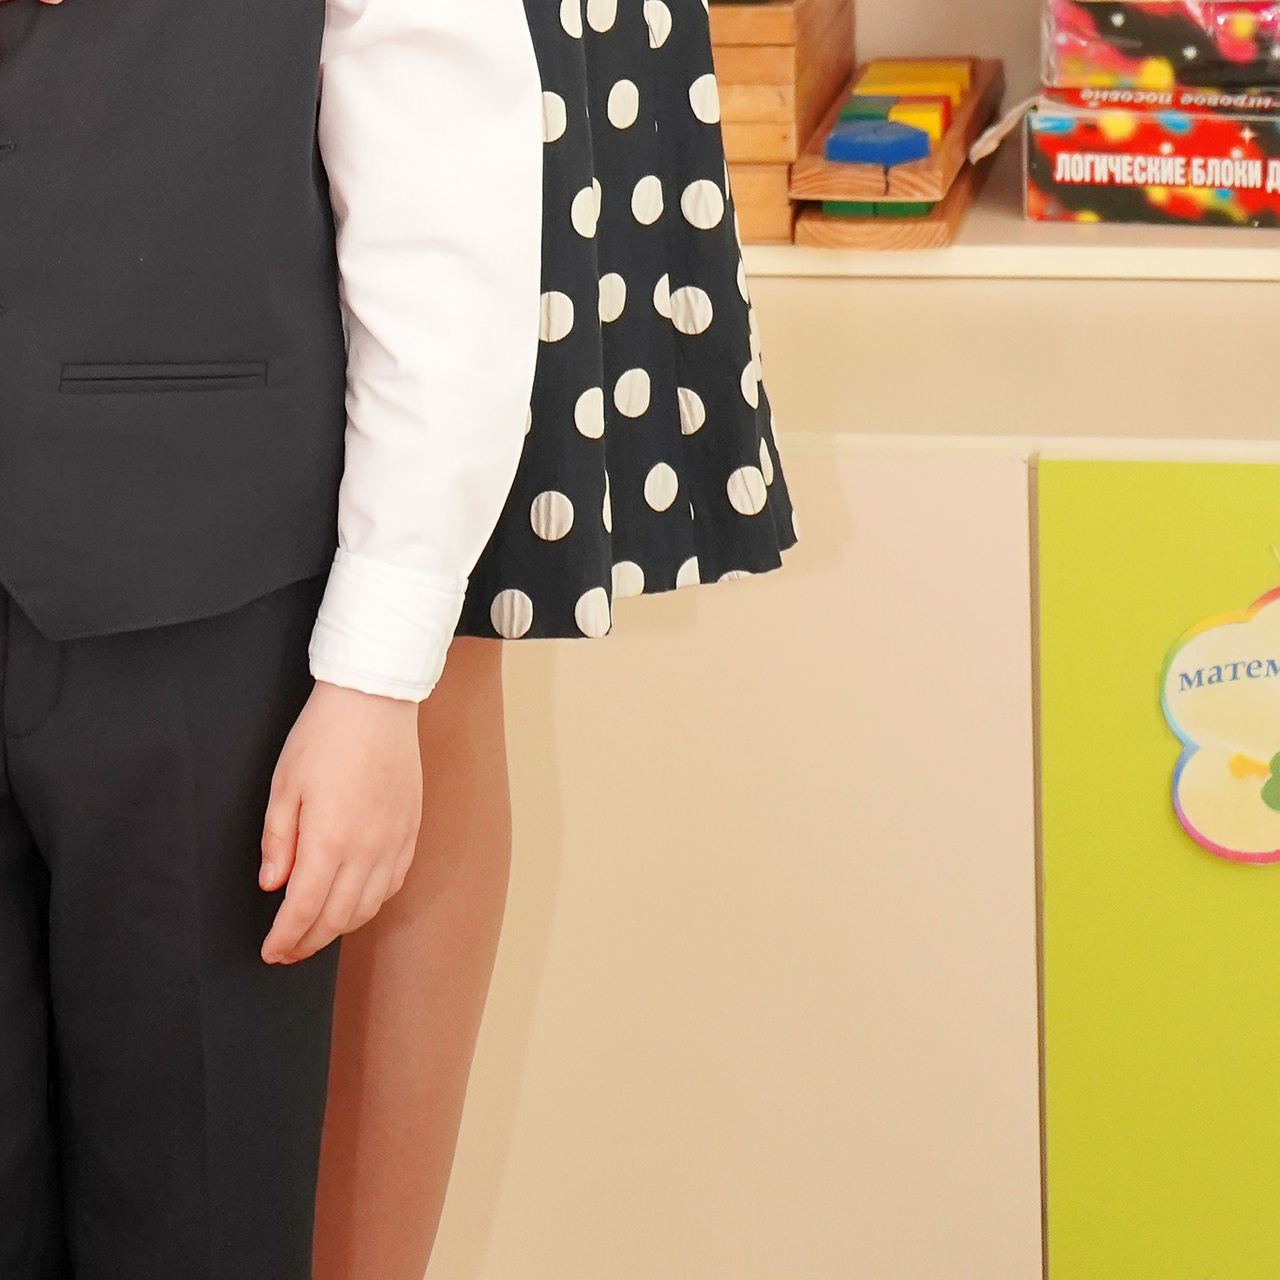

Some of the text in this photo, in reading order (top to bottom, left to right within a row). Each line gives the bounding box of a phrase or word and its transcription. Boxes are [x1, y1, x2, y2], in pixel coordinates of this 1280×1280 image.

[1080, 89, 1173, 108] пособие
[1055, 153, 1187, 186] ЛОГИЧЕСКИЕ
[1192, 158, 1262, 188] БЛОКИ
